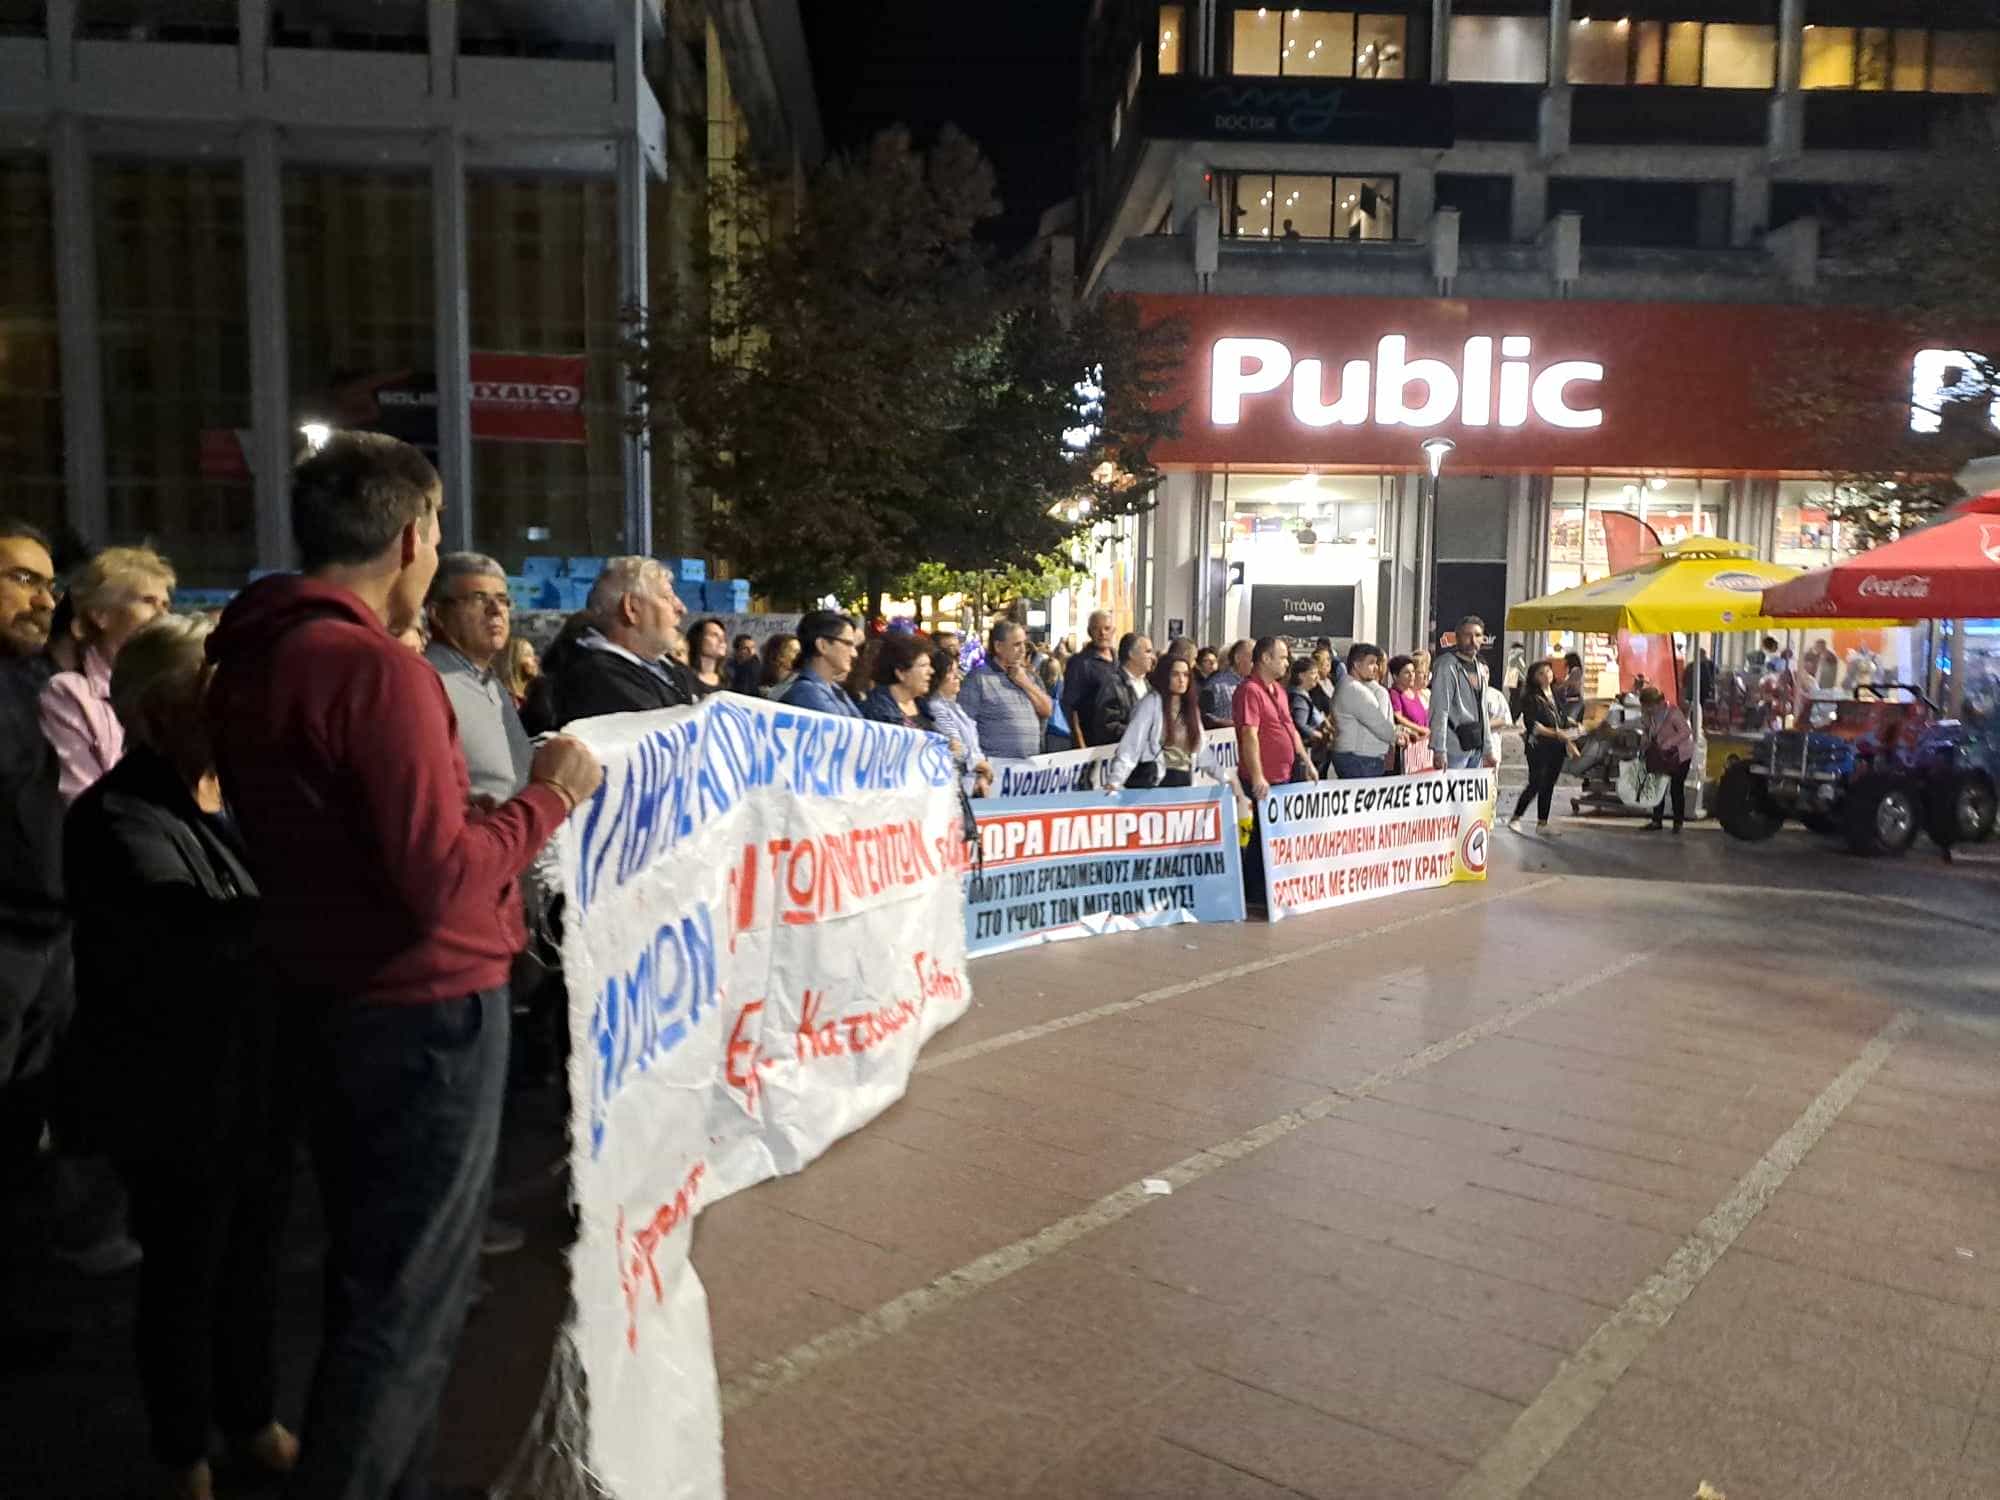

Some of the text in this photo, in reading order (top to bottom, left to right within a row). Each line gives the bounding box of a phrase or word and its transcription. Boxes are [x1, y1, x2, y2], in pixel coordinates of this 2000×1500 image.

[1210, 334, 1605, 429] Public
[1267, 776, 1489, 825] Ο ΚΟΜΠΟΣ ΕΦΤΑΣΕ ΣΤΟ ΧΤΕΝΙ
[1050, 808, 1217, 853] ΠΛΗΡΩΜΗ
[1294, 828, 1376, 861] ΟΛΟΚΛΗΡΩΜΕΝΗ
[1009, 869, 1036, 898] ΤΟΥΣ
[1037, 859, 1130, 891] ΕΡΓΑΖΟΜΕΝΟΥΣ
[1132, 857, 1152, 882] ΜΕ
[1154, 851, 1225, 876] ΑΝΑΣΤΟΛΗ
[1272, 850, 1455, 907] ΡΟΣΤΑΣΙΑ ΜΕ ΕΥΘΥΝΗ ΤΟΥ ΚΡΑΤΟΣ
[975, 908, 1002, 939] ΣΤΟ
[1007, 901, 1046, 933] ΥΨΟΣ
[1050, 899, 1079, 924] ΤΩΝ
[1083, 892, 1146, 917] ΜΙΣΘΩΝ
